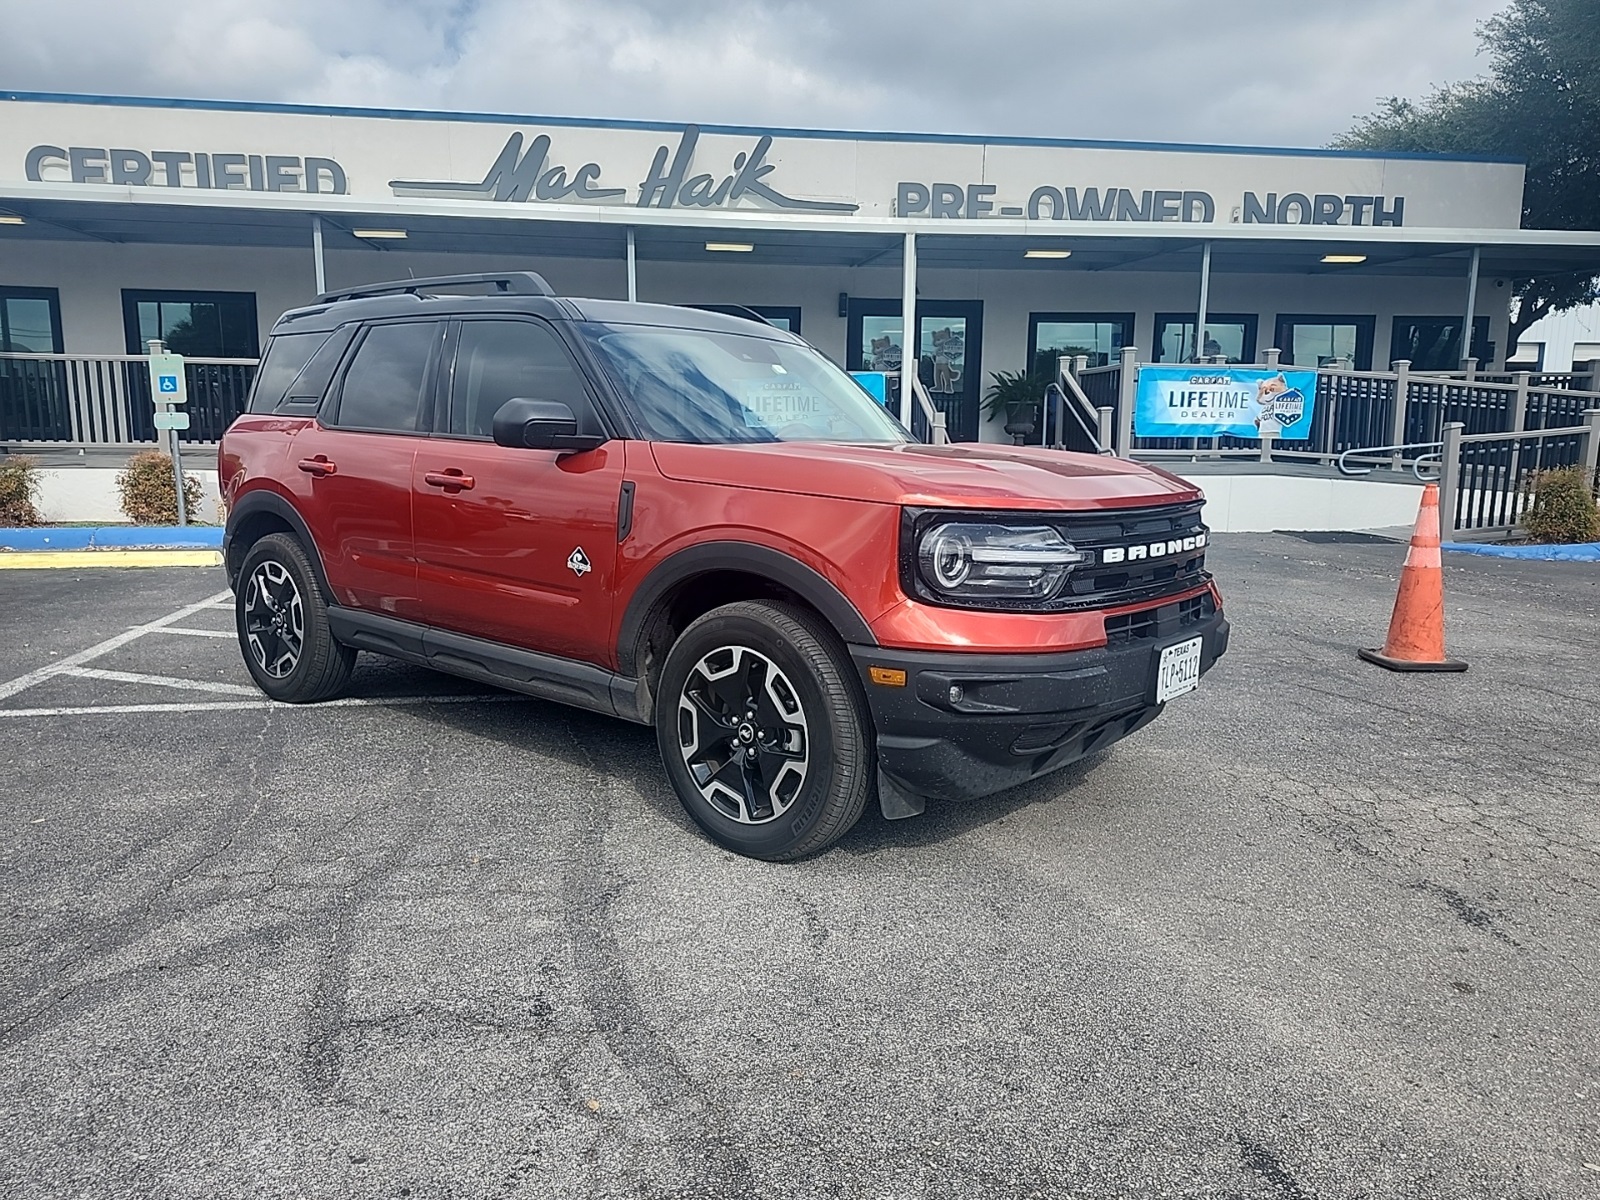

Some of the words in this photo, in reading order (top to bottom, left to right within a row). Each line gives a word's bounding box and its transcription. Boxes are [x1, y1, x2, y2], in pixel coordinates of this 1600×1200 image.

[25, 145, 347, 195] CERTIFIED
[388, 131, 626, 202] Mac
[636, 124, 858, 208] Haik
[898, 182, 1215, 222] PRE-OWNED
[1243, 191, 1405, 227] NORTH
[1189, 376, 1232, 386] CARFAX
[1168, 391, 1250, 409] LIFETIME
[1103, 534, 1206, 564] BRONCO
[1173, 644, 1190, 658] TEXAS
